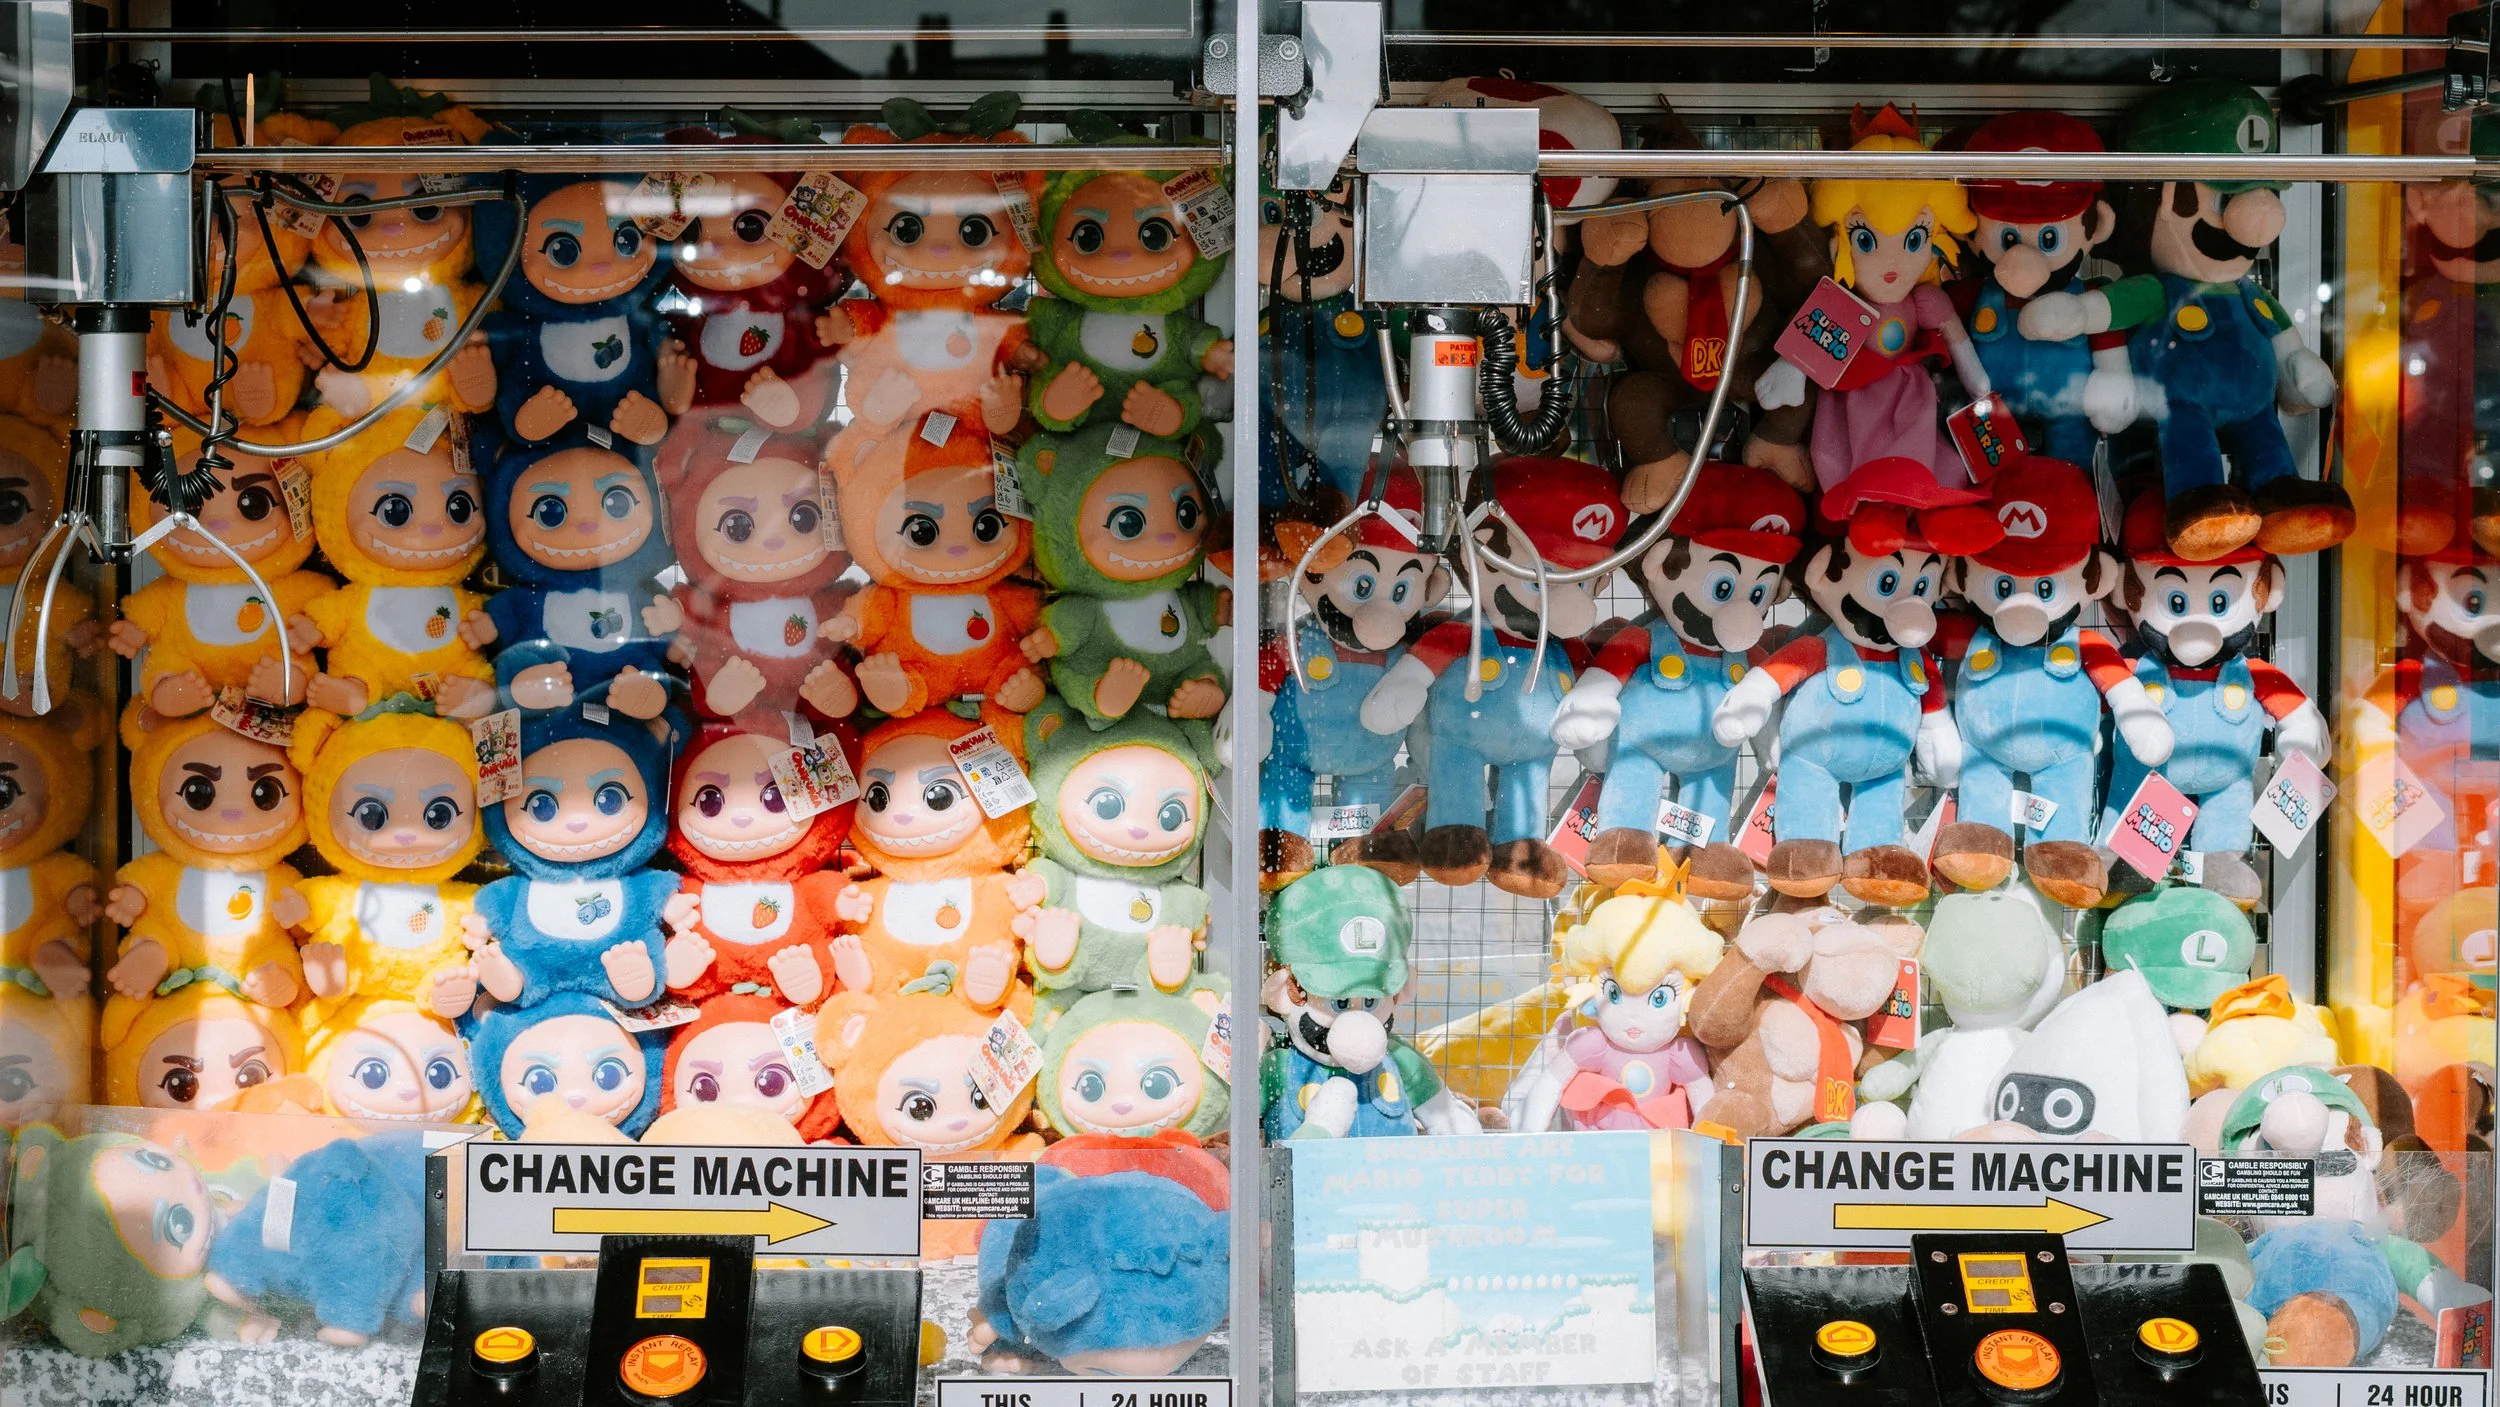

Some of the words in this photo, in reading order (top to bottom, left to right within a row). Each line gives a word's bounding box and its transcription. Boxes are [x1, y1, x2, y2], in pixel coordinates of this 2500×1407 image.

[79, 132, 128, 143] ELAUT
[2248, 119, 2264, 148] L
[1794, 314, 1848, 360] MARIO
[1810, 308, 1851, 345] SUPER
[1692, 339, 1725, 376] DK
[1576, 511, 1607, 535] M
[2002, 507, 2041, 531] M
[2267, 784, 2308, 830] MARIO
[2279, 778, 2312, 815] SUPER
[1328, 816, 1373, 831] MARIO
[1333, 807, 1368, 818] SUPER
[1661, 812, 1703, 838] MARIO
[1669, 805, 1702, 824] SUPER
[2139, 803, 2175, 837] SUPER
[2125, 810, 2173, 853] MARIO
[1354, 921, 1377, 949] L
[2196, 935, 2216, 962] L
[1824, 1078, 1850, 1119] DK
[480, 1153, 675, 1195] CHANGE
[693, 1156, 908, 1197] MACHINE
[948, 1165, 978, 1173] GAMBLE
[980, 1165, 1028, 1173] RESPONSIBLY
[1762, 1149, 1954, 1191] CHANGE
[1971, 1152, 2183, 1193] MACHINE
[2228, 1161, 2258, 1169] GAMBLE
[2260, 1161, 2308, 1169] RESPONSIBLY
[1322, 1165, 1424, 1196] MARIO
[1549, 1163, 1606, 1185] FOR
[962, 1205, 1019, 1213] www.gamcare.org.uk
[1436, 1199, 1528, 1221] SUPER
[2242, 1201, 2298, 1209] www.gamcare.org.uk
[1372, 1224, 1556, 1248] MUSHROOM
[627, 1340, 664, 1367] INSTANT
[670, 1340, 699, 1367] REPLAY
[1349, 1337, 1411, 1359] ASK
[1424, 1337, 1448, 1358] A
[1464, 1332, 1598, 1356] MEMBER
[1982, 1334, 2013, 1360] INSTANT
[2021, 1335, 2053, 1362] REPLAY
[1401, 1363, 1440, 1386] OF
[1456, 1361, 1551, 1385] STAFF
[981, 1393, 1031, 1407] THIS
[1111, 1393, 1137, 1407] 24
[1150, 1393, 1208, 1407] HOUR
[2367, 1384, 2394, 1407] 24
[2406, 1385, 2463, 1407] HOUR
